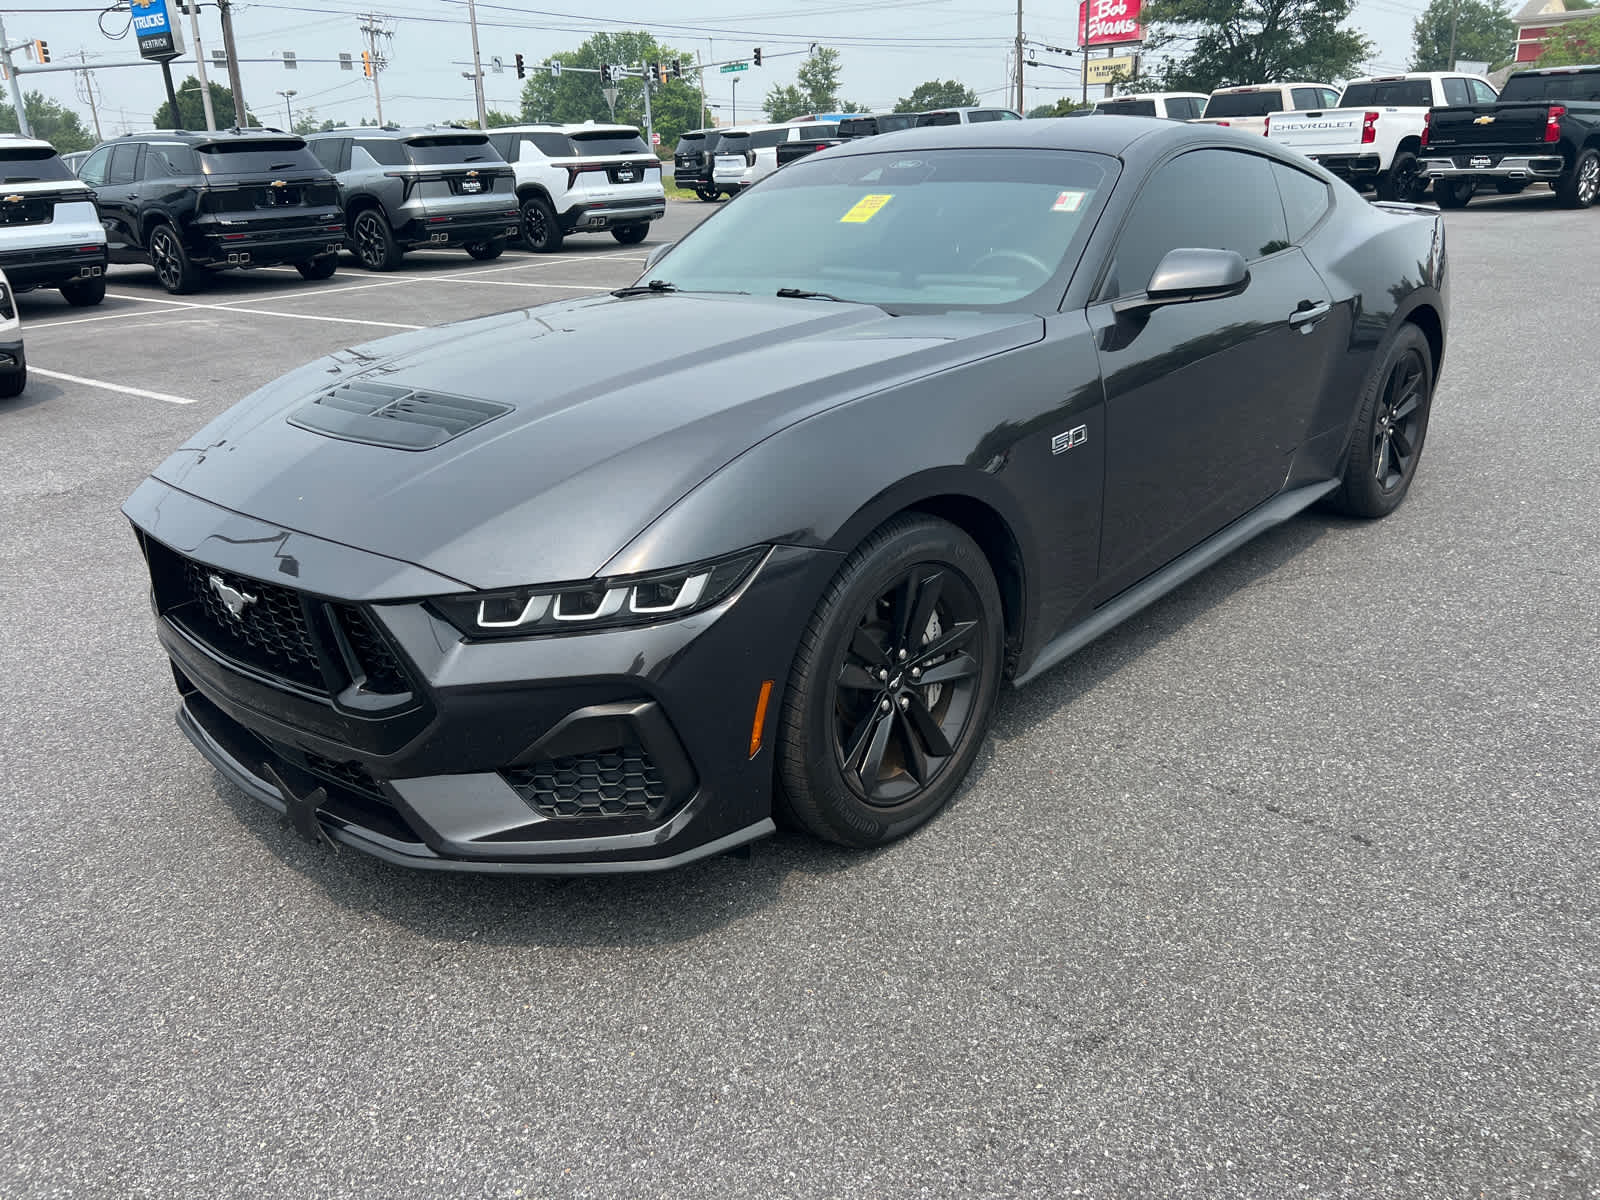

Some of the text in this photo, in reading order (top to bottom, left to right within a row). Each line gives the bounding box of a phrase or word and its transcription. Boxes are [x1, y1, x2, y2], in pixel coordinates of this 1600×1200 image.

[1093, 0, 1127, 19] Bob
[133, 12, 166, 30] TRUCKS
[1083, 16, 1136, 40] Evans
[141, 38, 168, 49] HERTRICH
[1272, 121, 1354, 131] CHEVROLET
